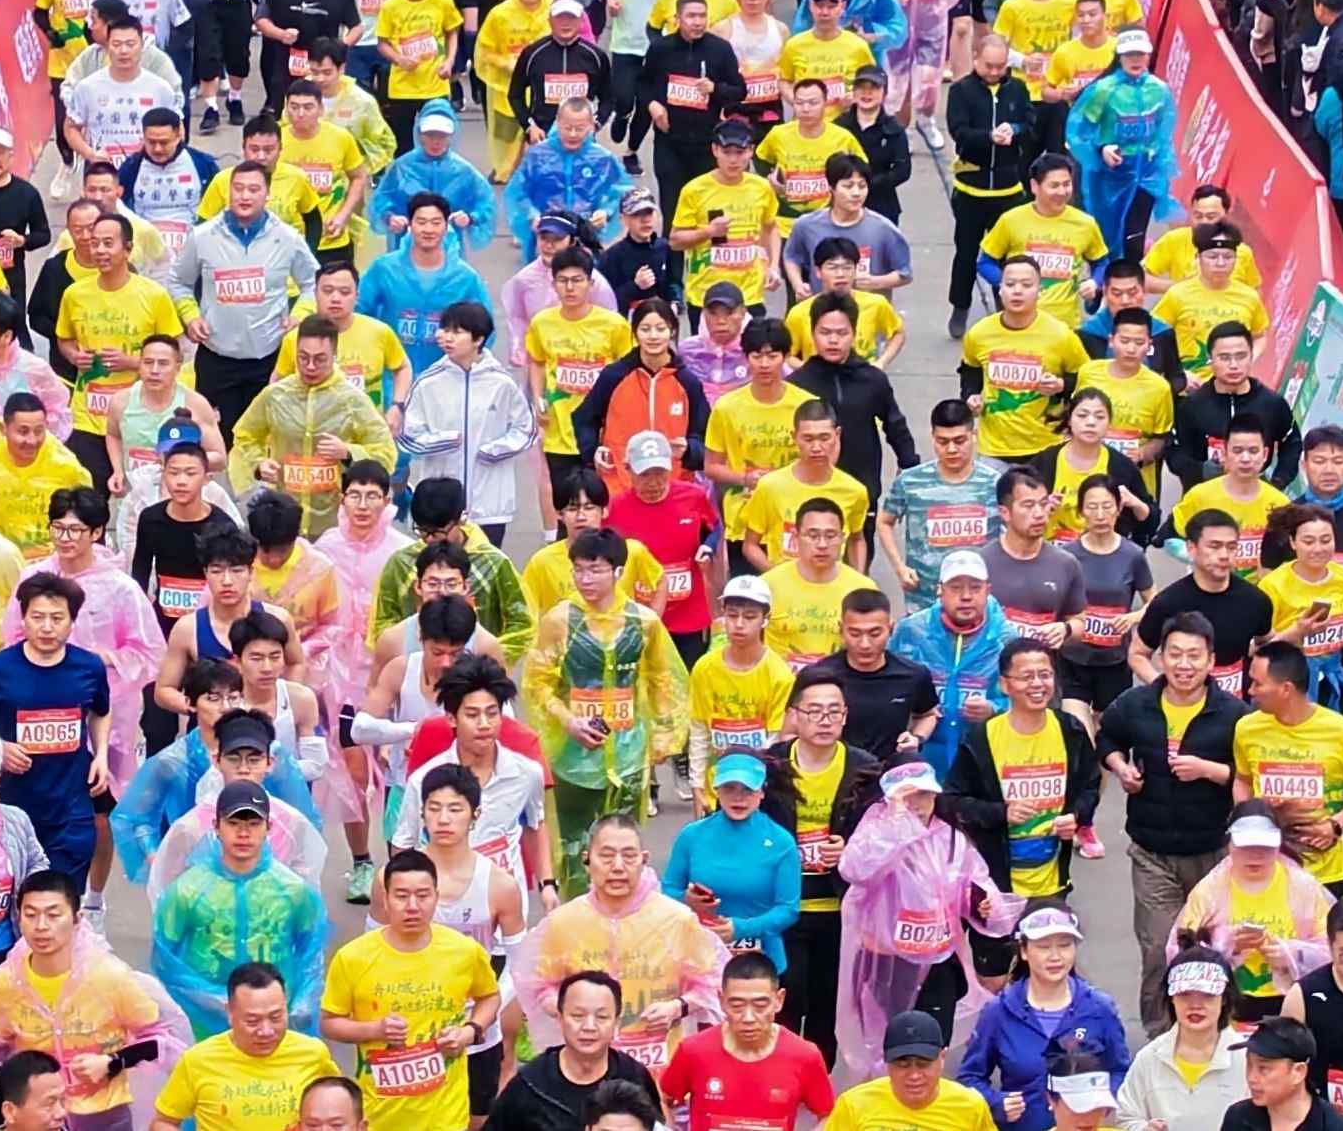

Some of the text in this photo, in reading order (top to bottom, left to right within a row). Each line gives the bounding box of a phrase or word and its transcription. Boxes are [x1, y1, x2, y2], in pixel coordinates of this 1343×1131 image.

[932, 520, 984, 537] A0046
[21, 723, 77, 743] A0965
[1007, 778, 1063, 799] A0098
[1264, 778, 1319, 797] A0449
[378, 1056, 441, 1086] A1050
